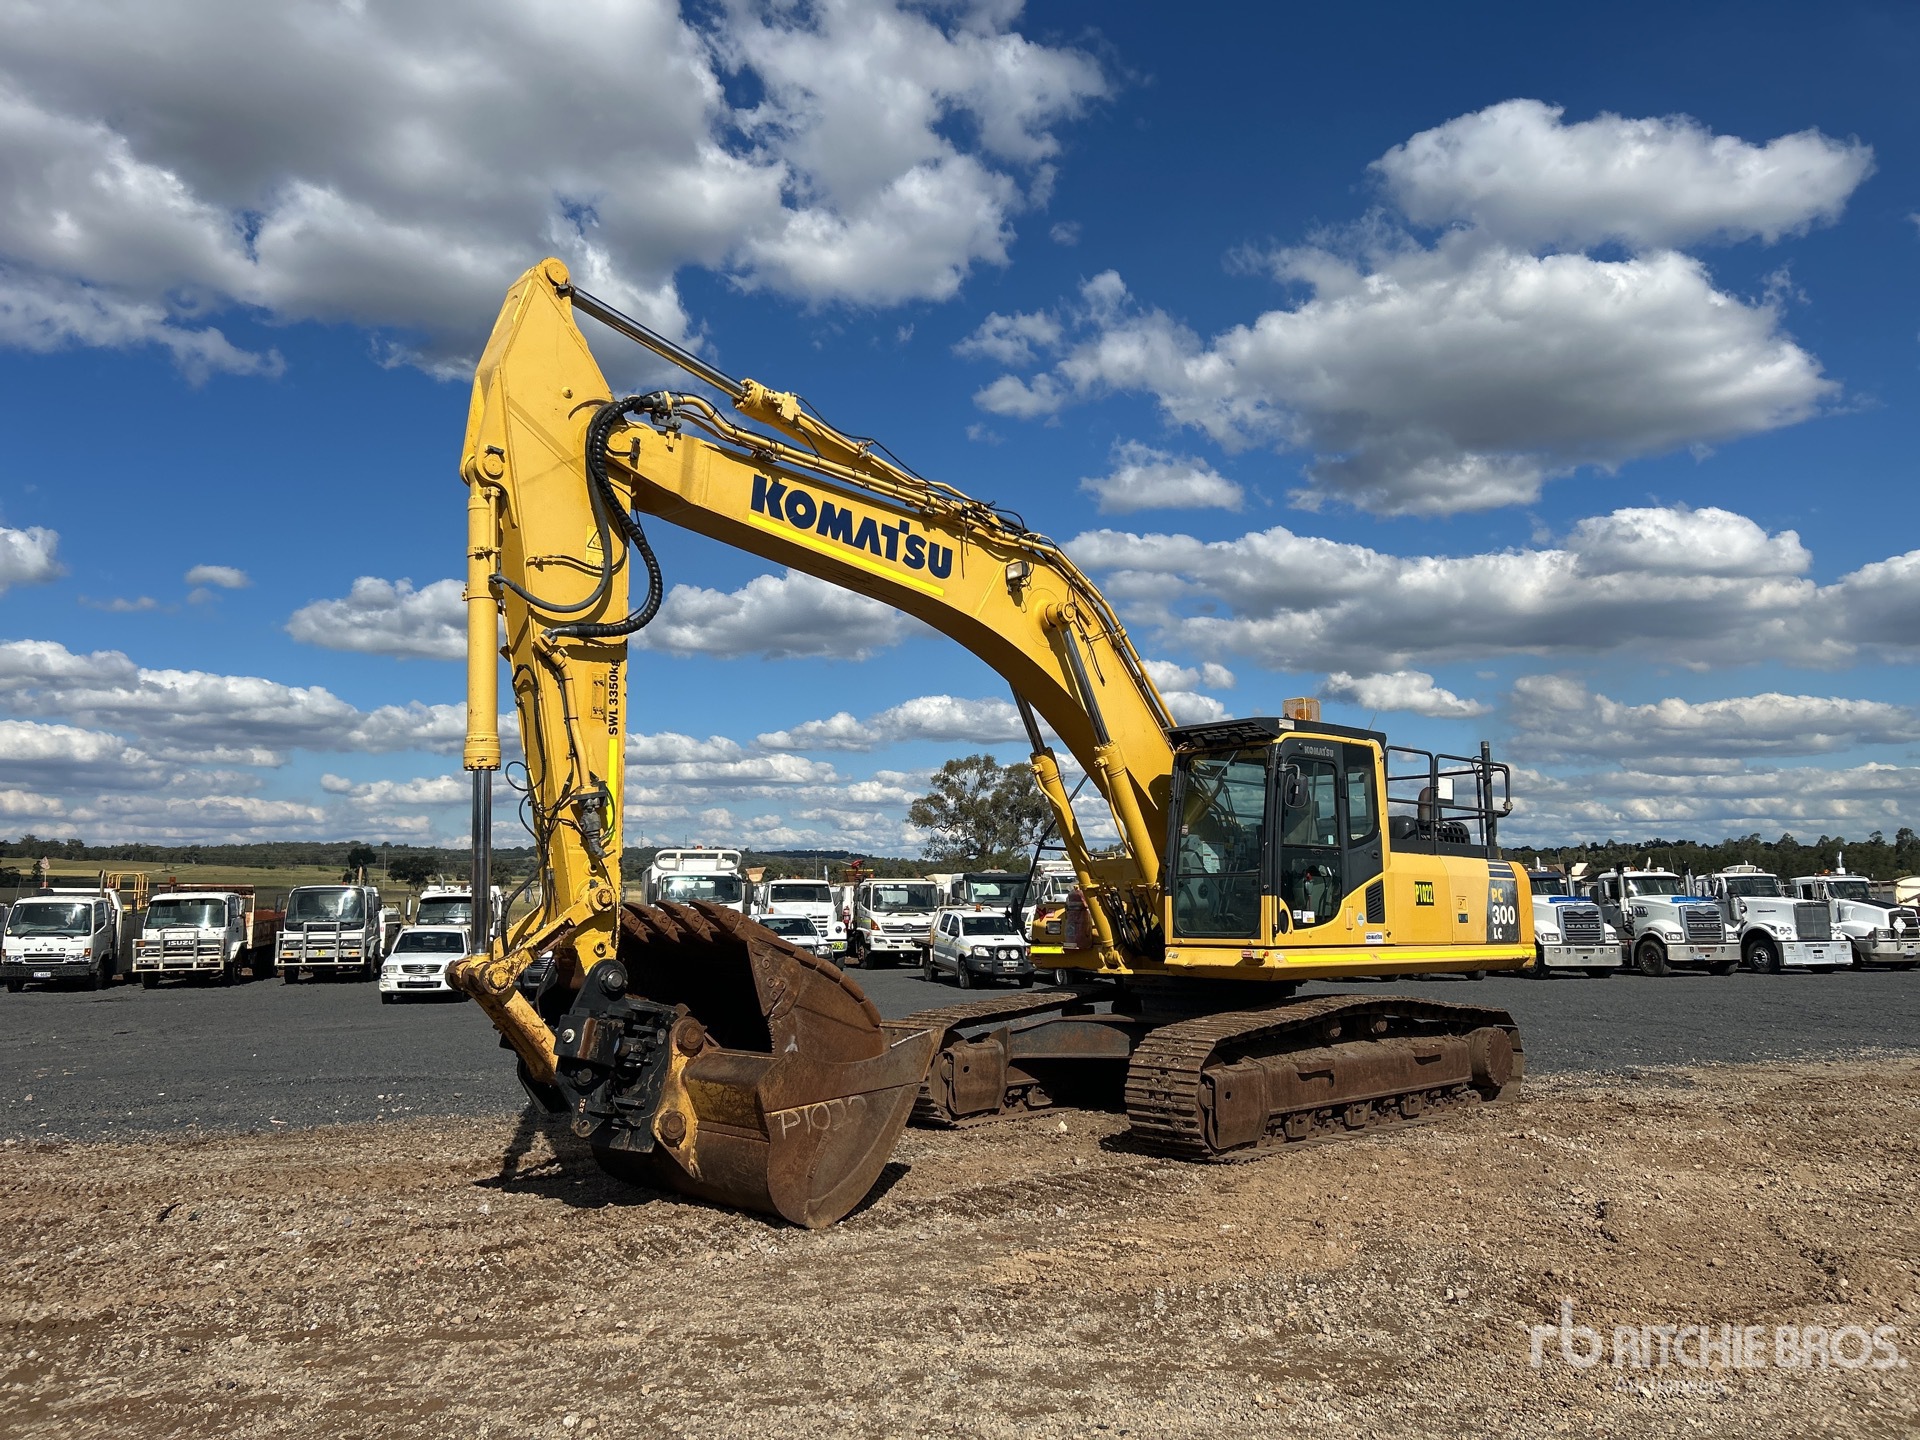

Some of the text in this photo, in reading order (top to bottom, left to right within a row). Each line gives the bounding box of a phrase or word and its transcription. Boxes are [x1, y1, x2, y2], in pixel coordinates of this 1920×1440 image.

[751, 474, 953, 579] KOMATSU
[608, 658, 621, 736] SWL 3350kg
[1304, 745, 1335, 758] KOMATSU
[1415, 884, 1434, 903] P1022
[1491, 887, 1504, 903] PC
[1492, 905, 1516, 925] 300
[1493, 927, 1503, 940] LC
